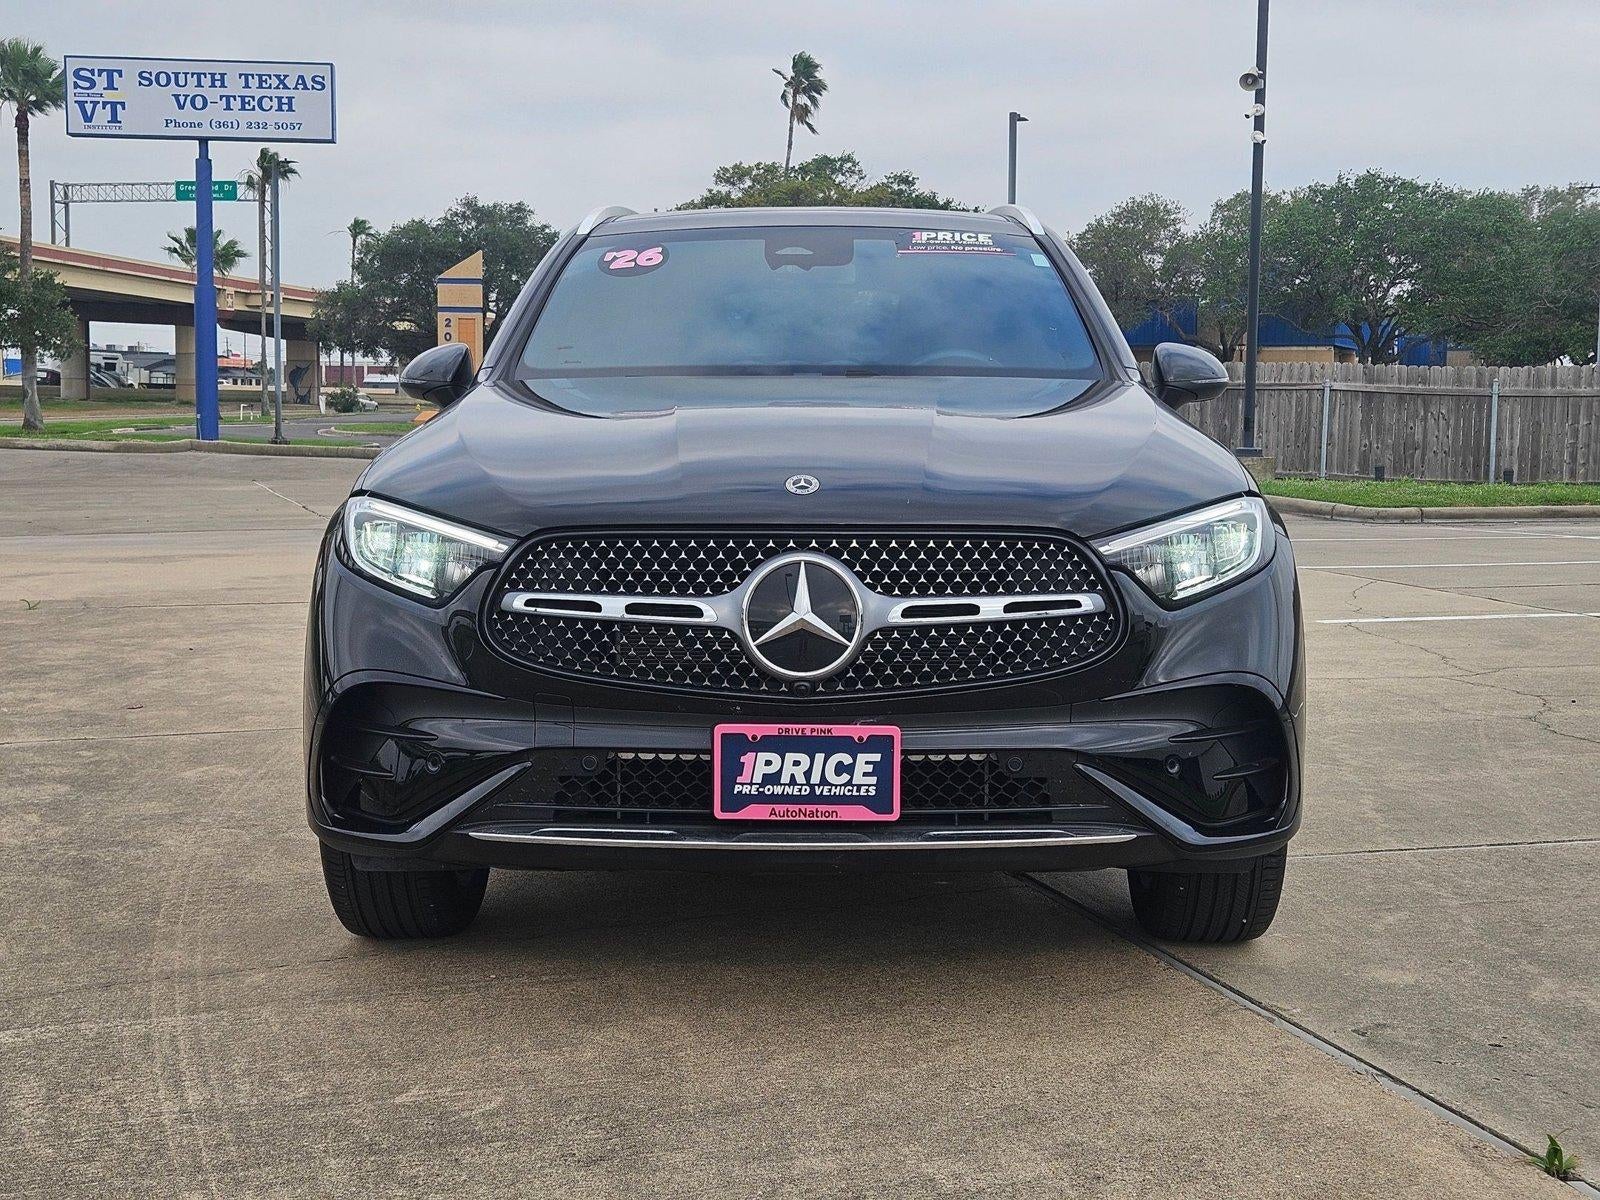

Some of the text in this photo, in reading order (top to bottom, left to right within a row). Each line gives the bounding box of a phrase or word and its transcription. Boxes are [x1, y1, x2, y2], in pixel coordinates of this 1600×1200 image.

[73, 67, 123, 91] ST
[137, 70, 326, 91] SOUTH TEXAS
[74, 100, 126, 124] VT
[171, 93, 296, 113] VO-TECH
[164, 118, 303, 131] Phone (361) 232-5057
[912, 231, 993, 242] 1PRICE
[603, 247, 664, 270] '26
[777, 727, 833, 736] DRIVE PINK
[736, 751, 882, 785] 1PRICE
[733, 784, 877, 796] PRE-OWNED VEHICLES
